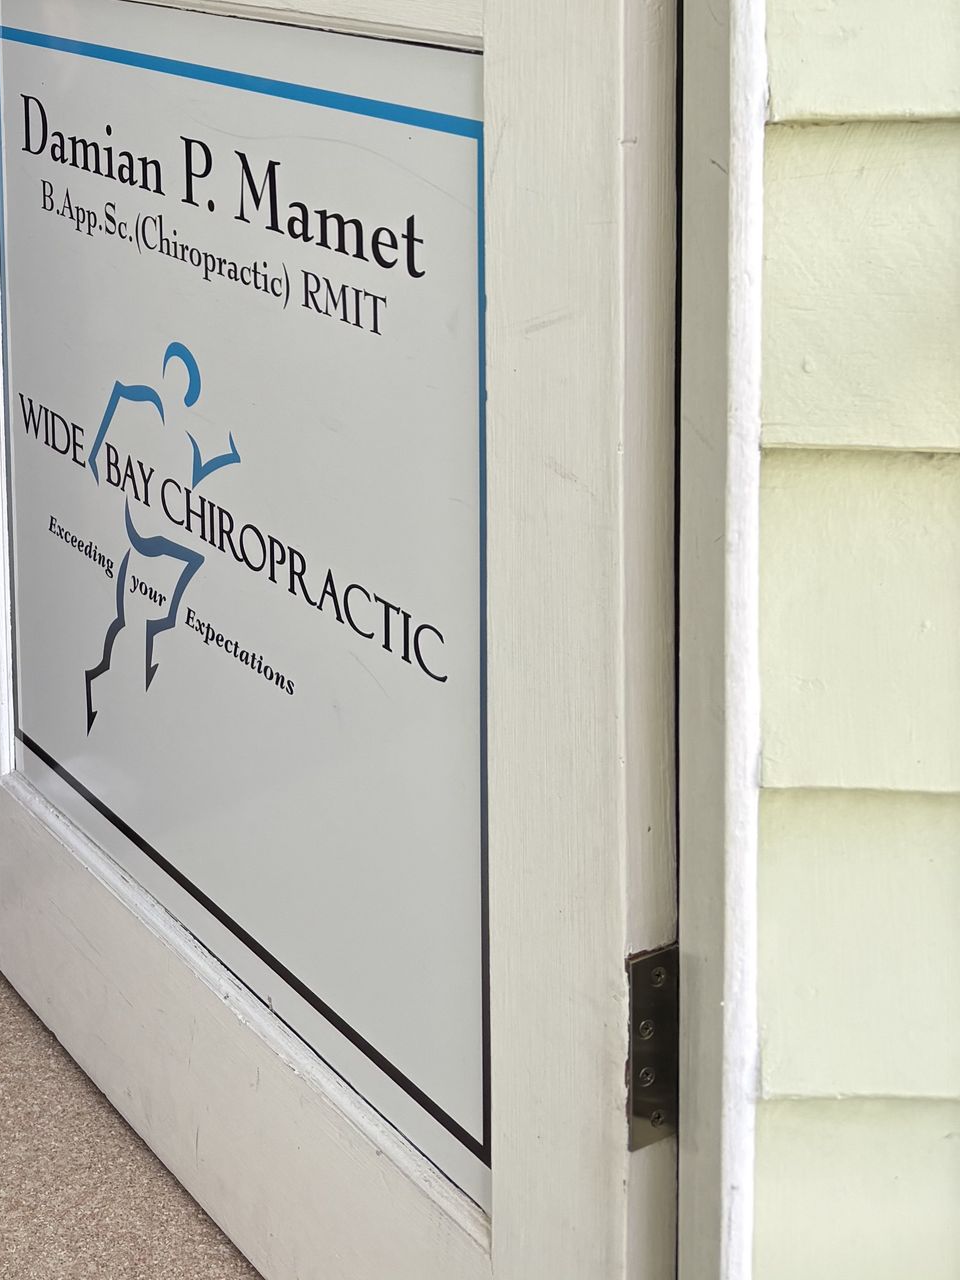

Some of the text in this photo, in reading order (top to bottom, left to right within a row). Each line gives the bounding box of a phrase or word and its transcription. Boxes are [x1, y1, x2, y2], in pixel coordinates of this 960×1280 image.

[20, 93, 426, 279] Damian P. Mamet
[301, 269, 387, 336] RMIT
[18, 392, 449, 684] WIDE BAY CHIROPRACTIC
[48, 515, 296, 696] Exceeding your Expectations
